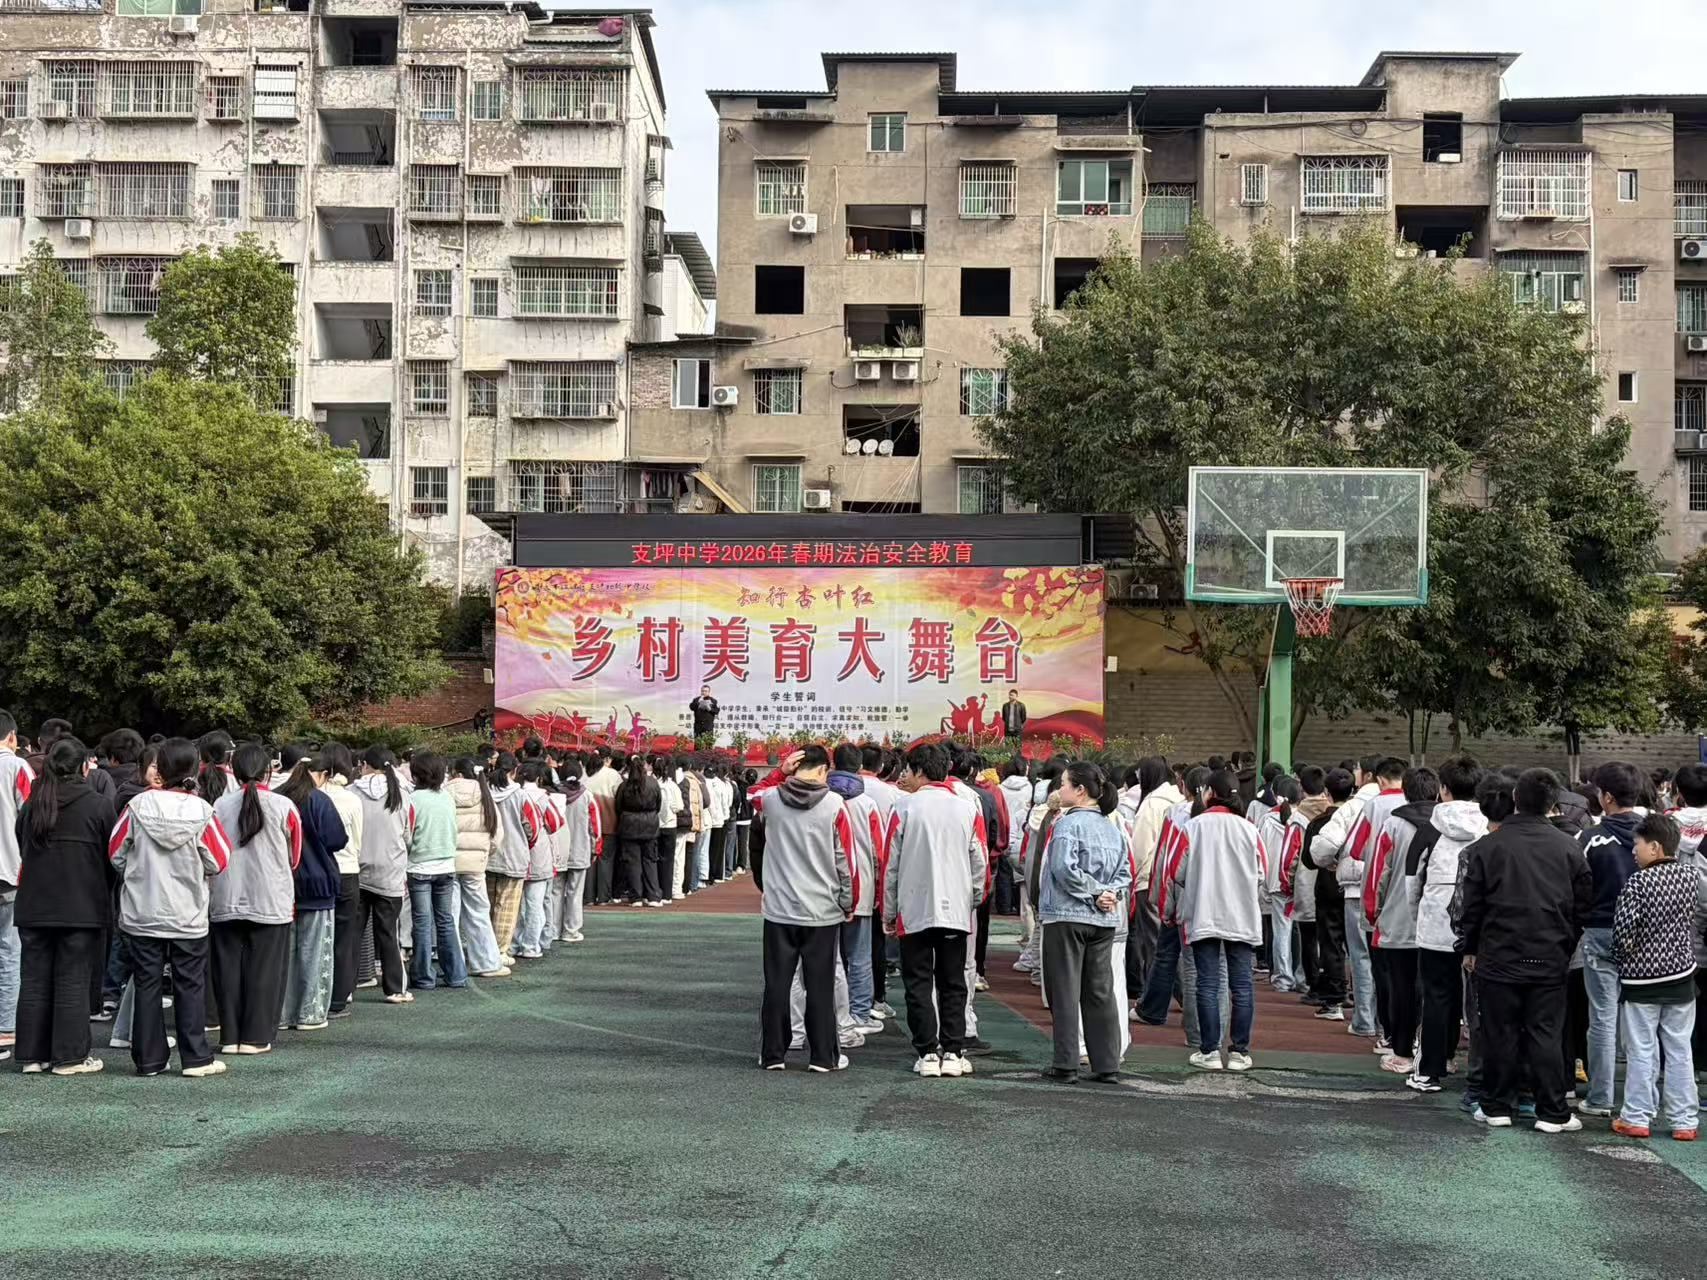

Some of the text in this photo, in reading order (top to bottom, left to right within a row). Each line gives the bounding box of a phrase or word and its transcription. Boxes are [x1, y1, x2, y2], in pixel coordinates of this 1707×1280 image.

[631, 542, 973, 564] 支坪中学2026年春期法治安全教育
[737, 584, 876, 608] 知行杏叶红
[571, 616, 1023, 683] 乡村美育大舞台
[770, 691, 817, 702] 学生誓词
